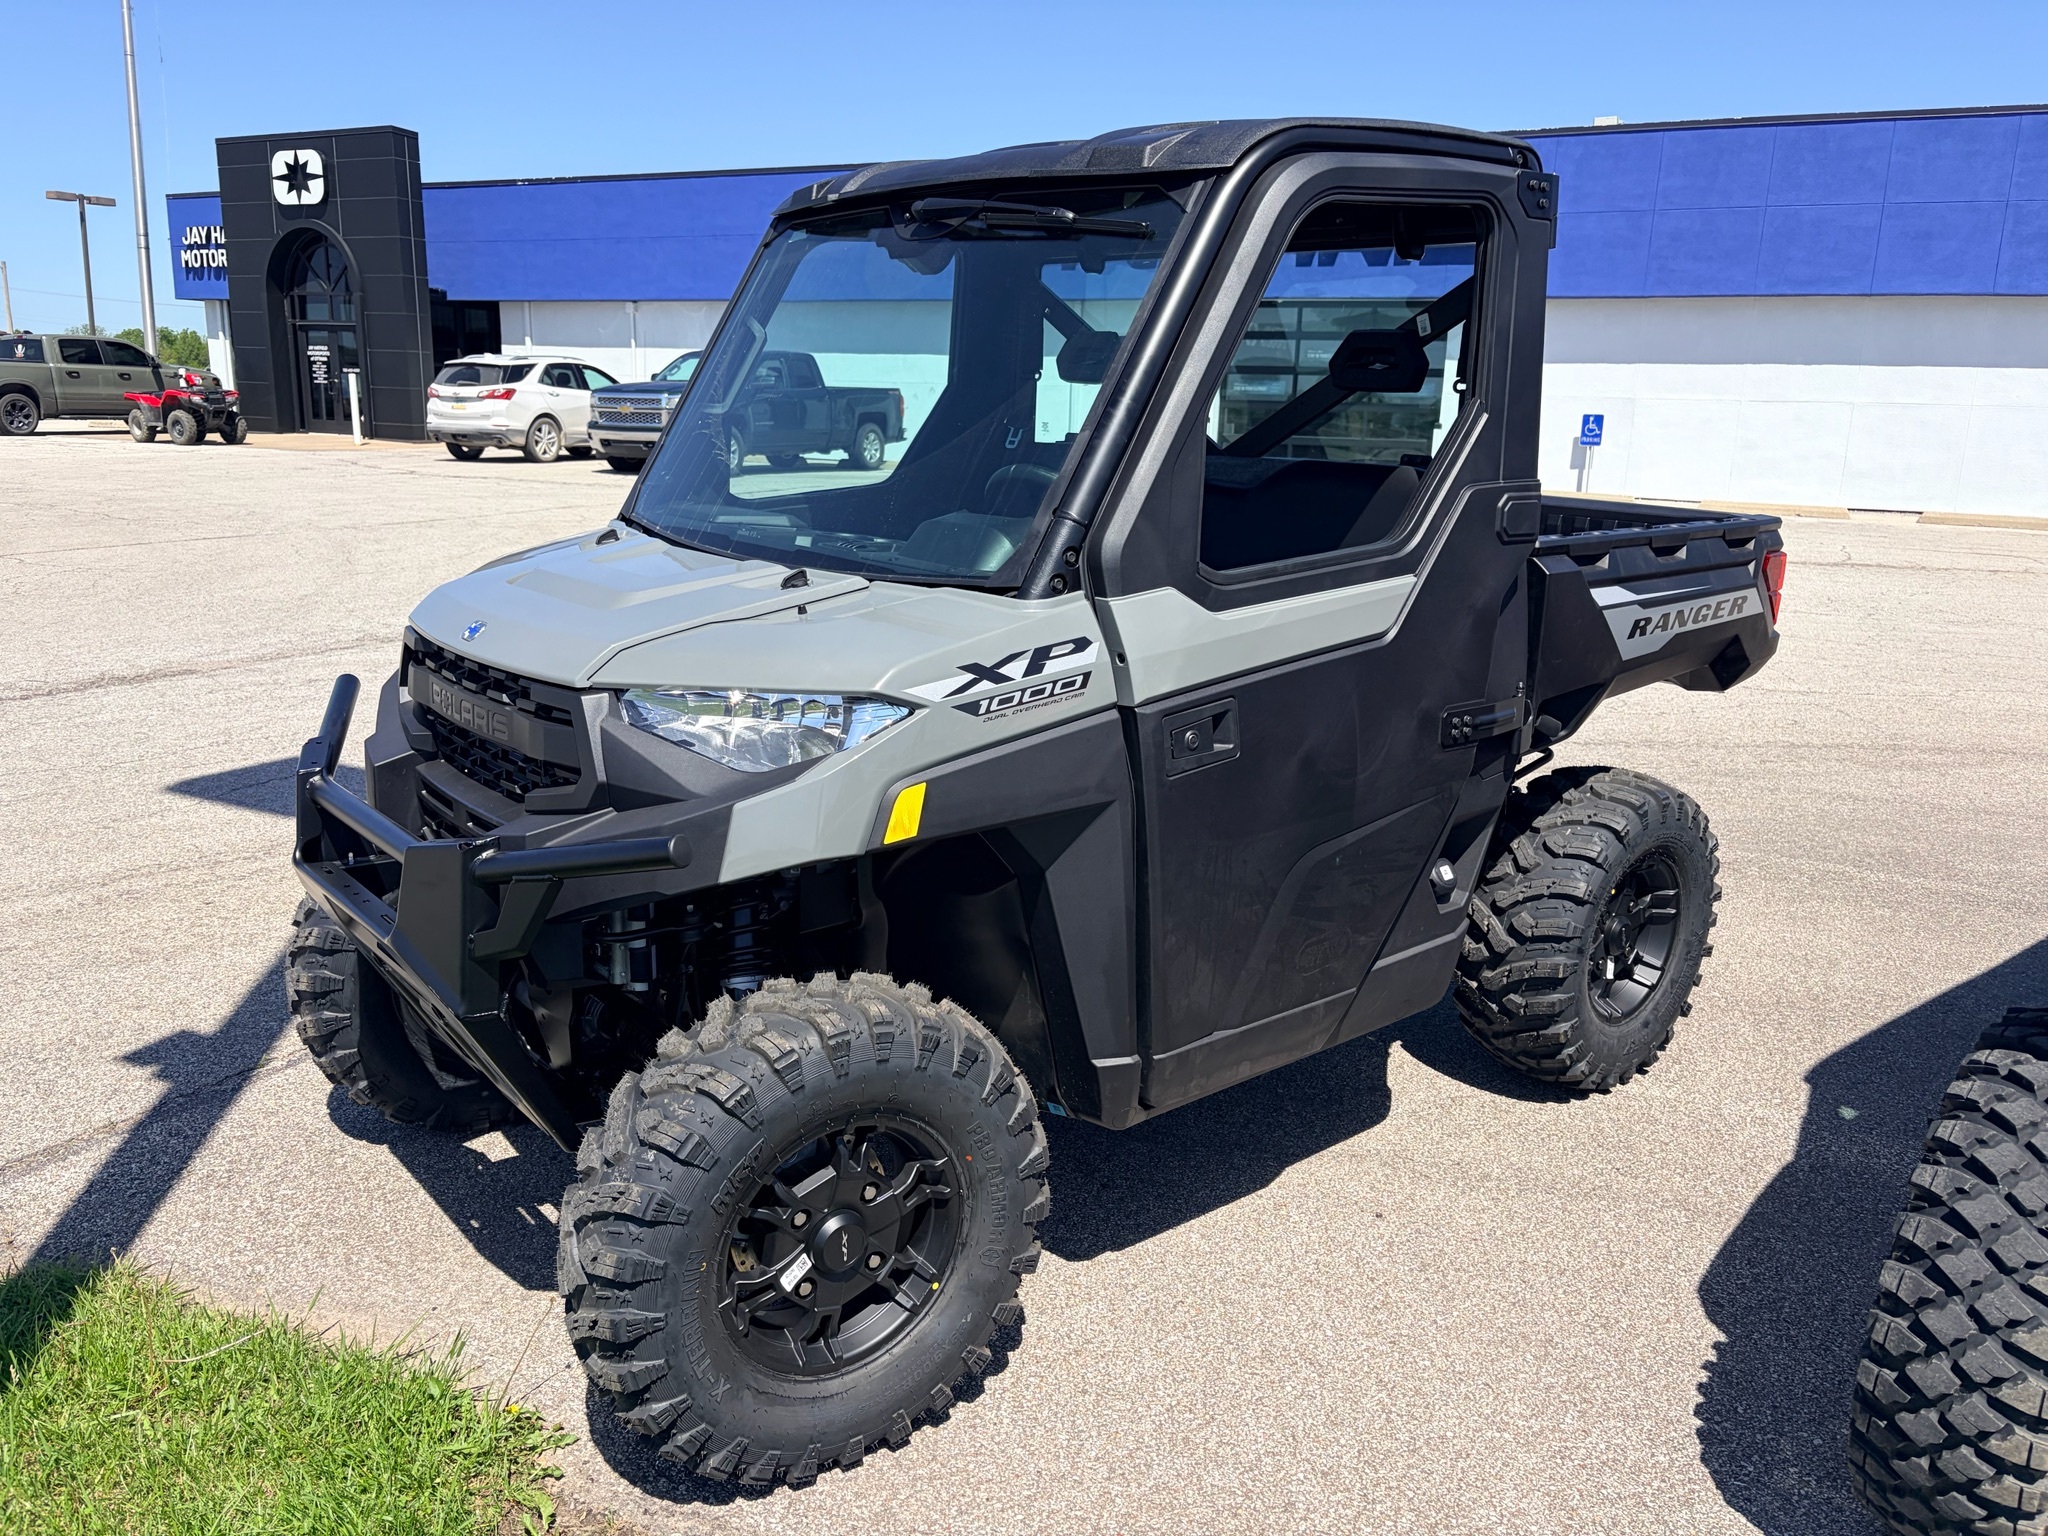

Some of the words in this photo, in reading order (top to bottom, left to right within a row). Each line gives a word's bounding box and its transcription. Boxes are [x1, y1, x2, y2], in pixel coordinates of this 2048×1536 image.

[182, 226, 208, 245] JAY
[180, 248, 228, 268] MOTOR
[1626, 595, 1748, 640] RANGER
[940, 635, 1093, 699] XP
[431, 681, 509, 741] POLARIS
[978, 675, 1084, 715] 1000
[982, 712, 1010, 723] DUAL
[1011, 697, 1063, 715] OVERHEAD
[1064, 691, 1085, 701] CAM
[966, 1120, 997, 1162] PRO
[986, 1163, 1008, 1244] ARMOR
[841, 1230, 848, 1262] XP
[680, 1248, 732, 1405] X-TERRAIN
